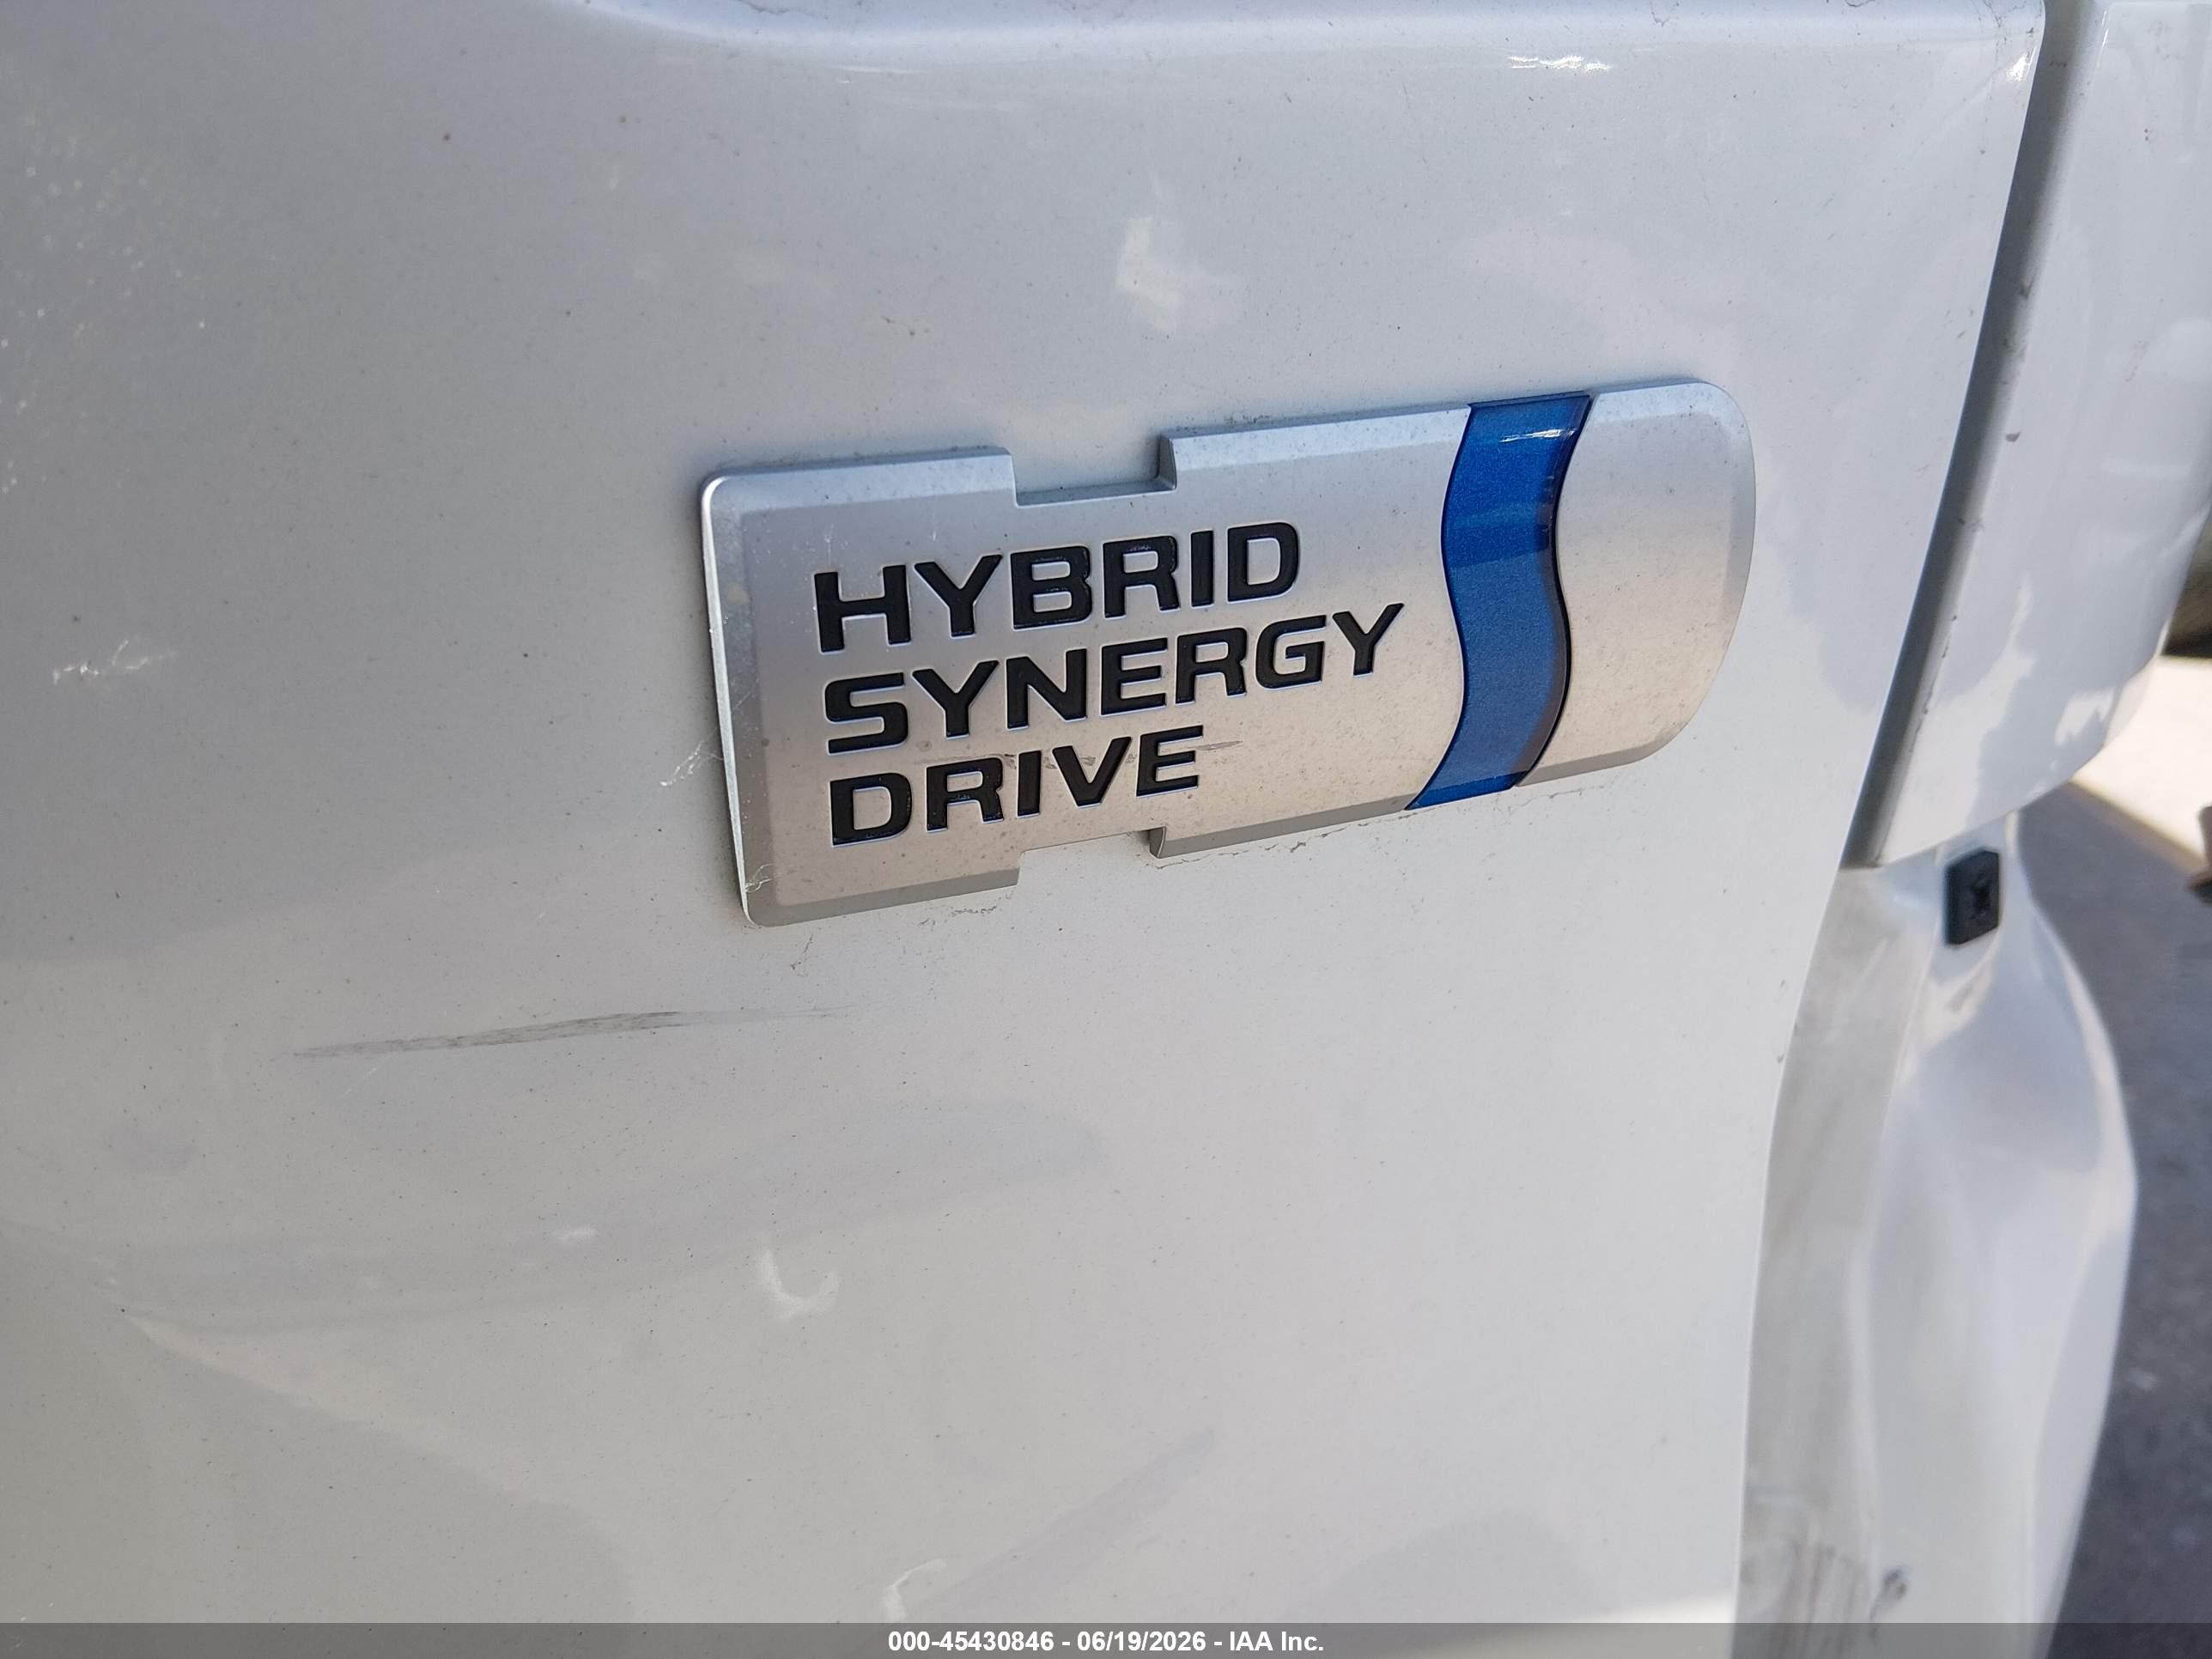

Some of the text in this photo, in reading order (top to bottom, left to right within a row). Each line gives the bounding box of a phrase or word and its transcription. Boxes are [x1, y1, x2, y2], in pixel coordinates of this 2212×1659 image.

[813, 521, 1300, 653] HYBRID
[824, 603, 1405, 754] SYNERGY
[830, 725, 1204, 846] DRIVE
